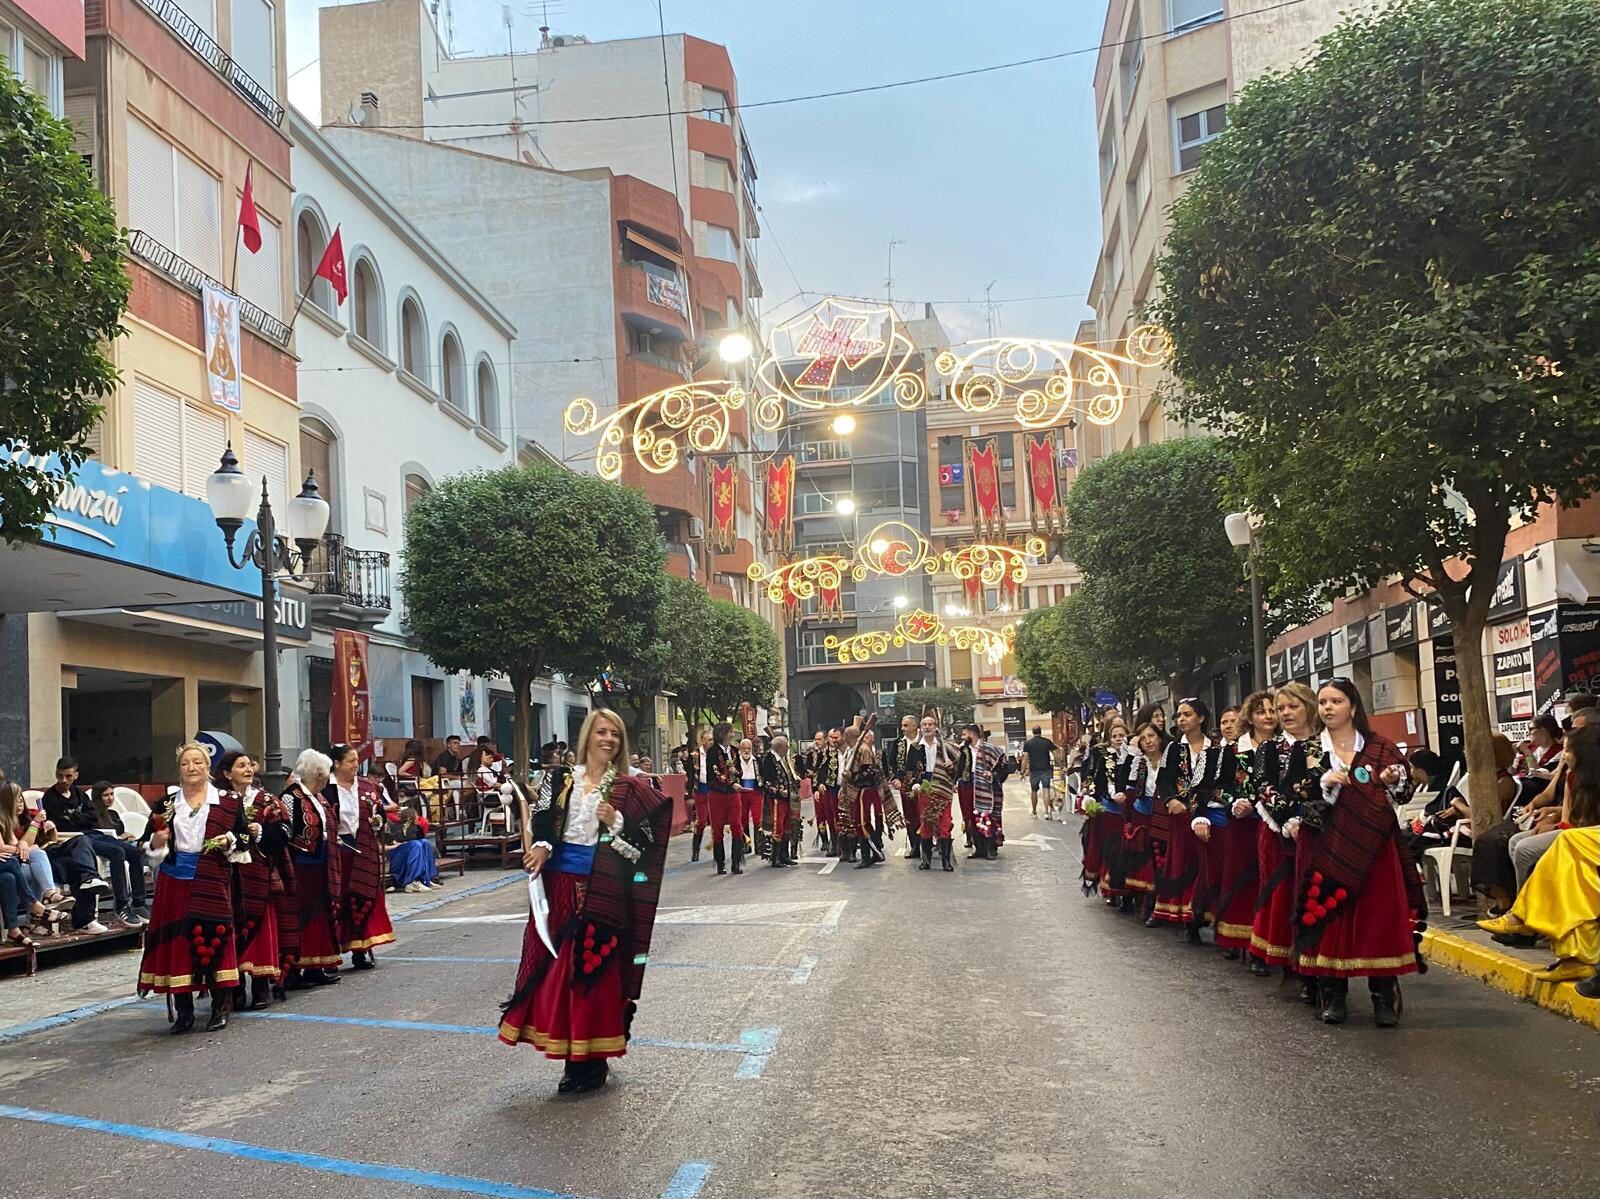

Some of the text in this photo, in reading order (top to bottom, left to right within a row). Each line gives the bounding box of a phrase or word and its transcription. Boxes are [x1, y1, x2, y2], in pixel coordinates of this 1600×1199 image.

[1498, 626, 1519, 645] SOLO
[1497, 653, 1522, 671] ZAPATO
[1445, 669, 1456, 680] P
